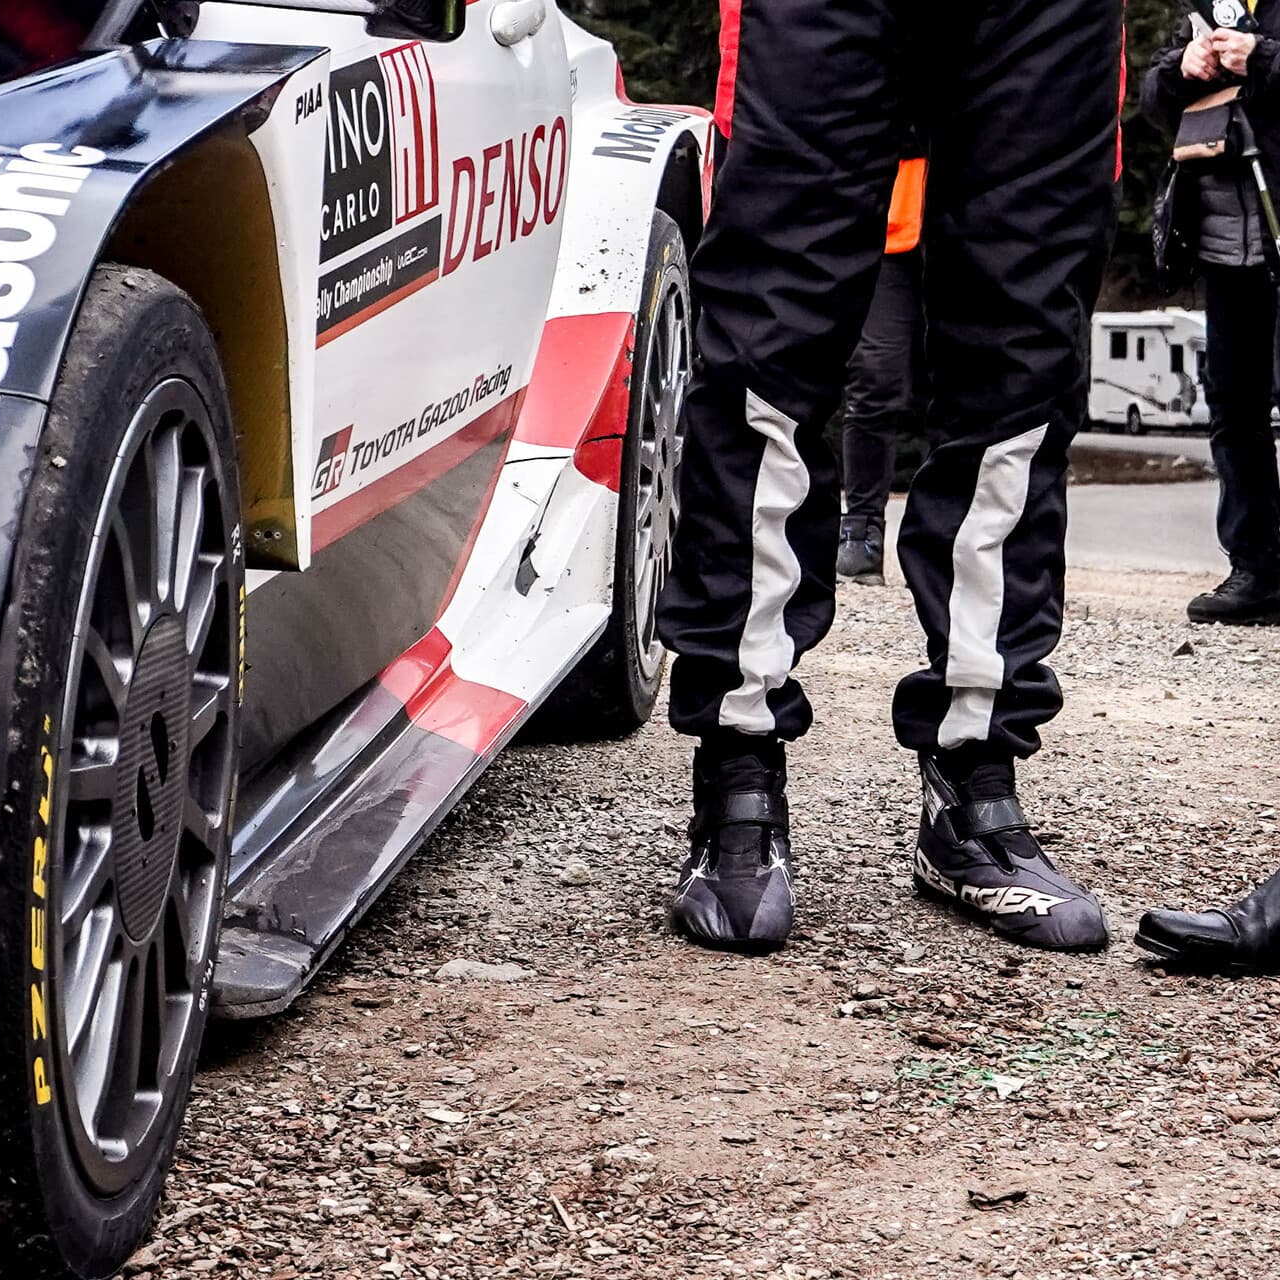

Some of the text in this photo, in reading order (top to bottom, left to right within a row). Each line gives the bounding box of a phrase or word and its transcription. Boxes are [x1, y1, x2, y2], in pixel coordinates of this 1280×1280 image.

[326, 79, 385, 174] INO
[320, 181, 381, 242] CARLO
[442, 115, 566, 277] DENSO
[316, 255, 394, 319] ally Championship
[312, 364, 513, 496] GR TOYOTA GAZOO Racing
